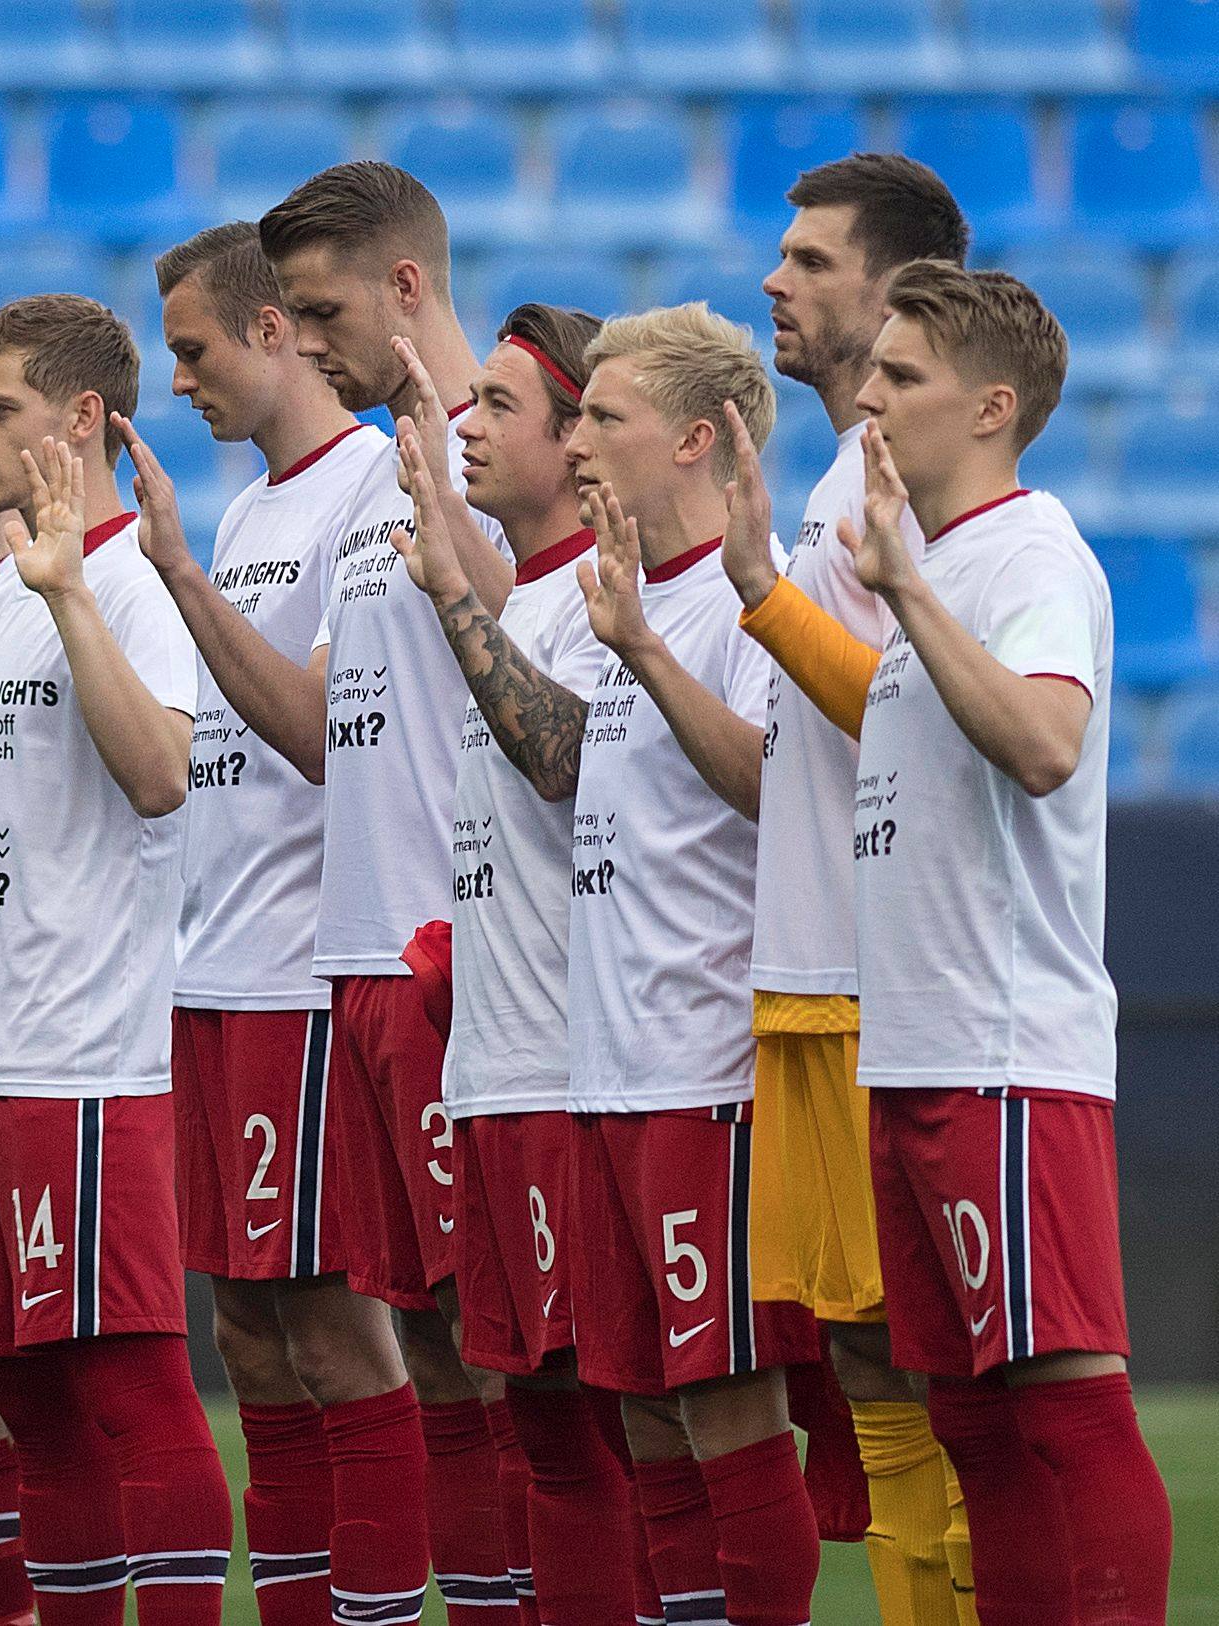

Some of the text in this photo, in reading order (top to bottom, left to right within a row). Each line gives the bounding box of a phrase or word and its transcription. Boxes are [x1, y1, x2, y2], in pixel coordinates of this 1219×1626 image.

[214, 560, 301, 592] MAN RIGHTS
[356, 553, 378, 576] and
[377, 551, 398, 573] off
[241, 592, 262, 614] off
[353, 577, 387, 603] pitch
[330, 687, 370, 706] Gerany
[594, 695, 618, 718] and
[617, 694, 637, 717] off
[196, 708, 226, 724] orway
[328, 711, 386, 753] Nxt?
[191, 728, 232, 743] ermany
[593, 722, 628, 747] pitch
[188, 751, 247, 792] Next?
[854, 819, 897, 861] ext?
[244, 1113, 279, 1200] 2
[421, 1101, 454, 1187] 3
[12, 1183, 65, 1274] 14
[529, 1185, 556, 1273] 8
[942, 1199, 990, 1293] 10
[662, 1208, 708, 1302] 5
